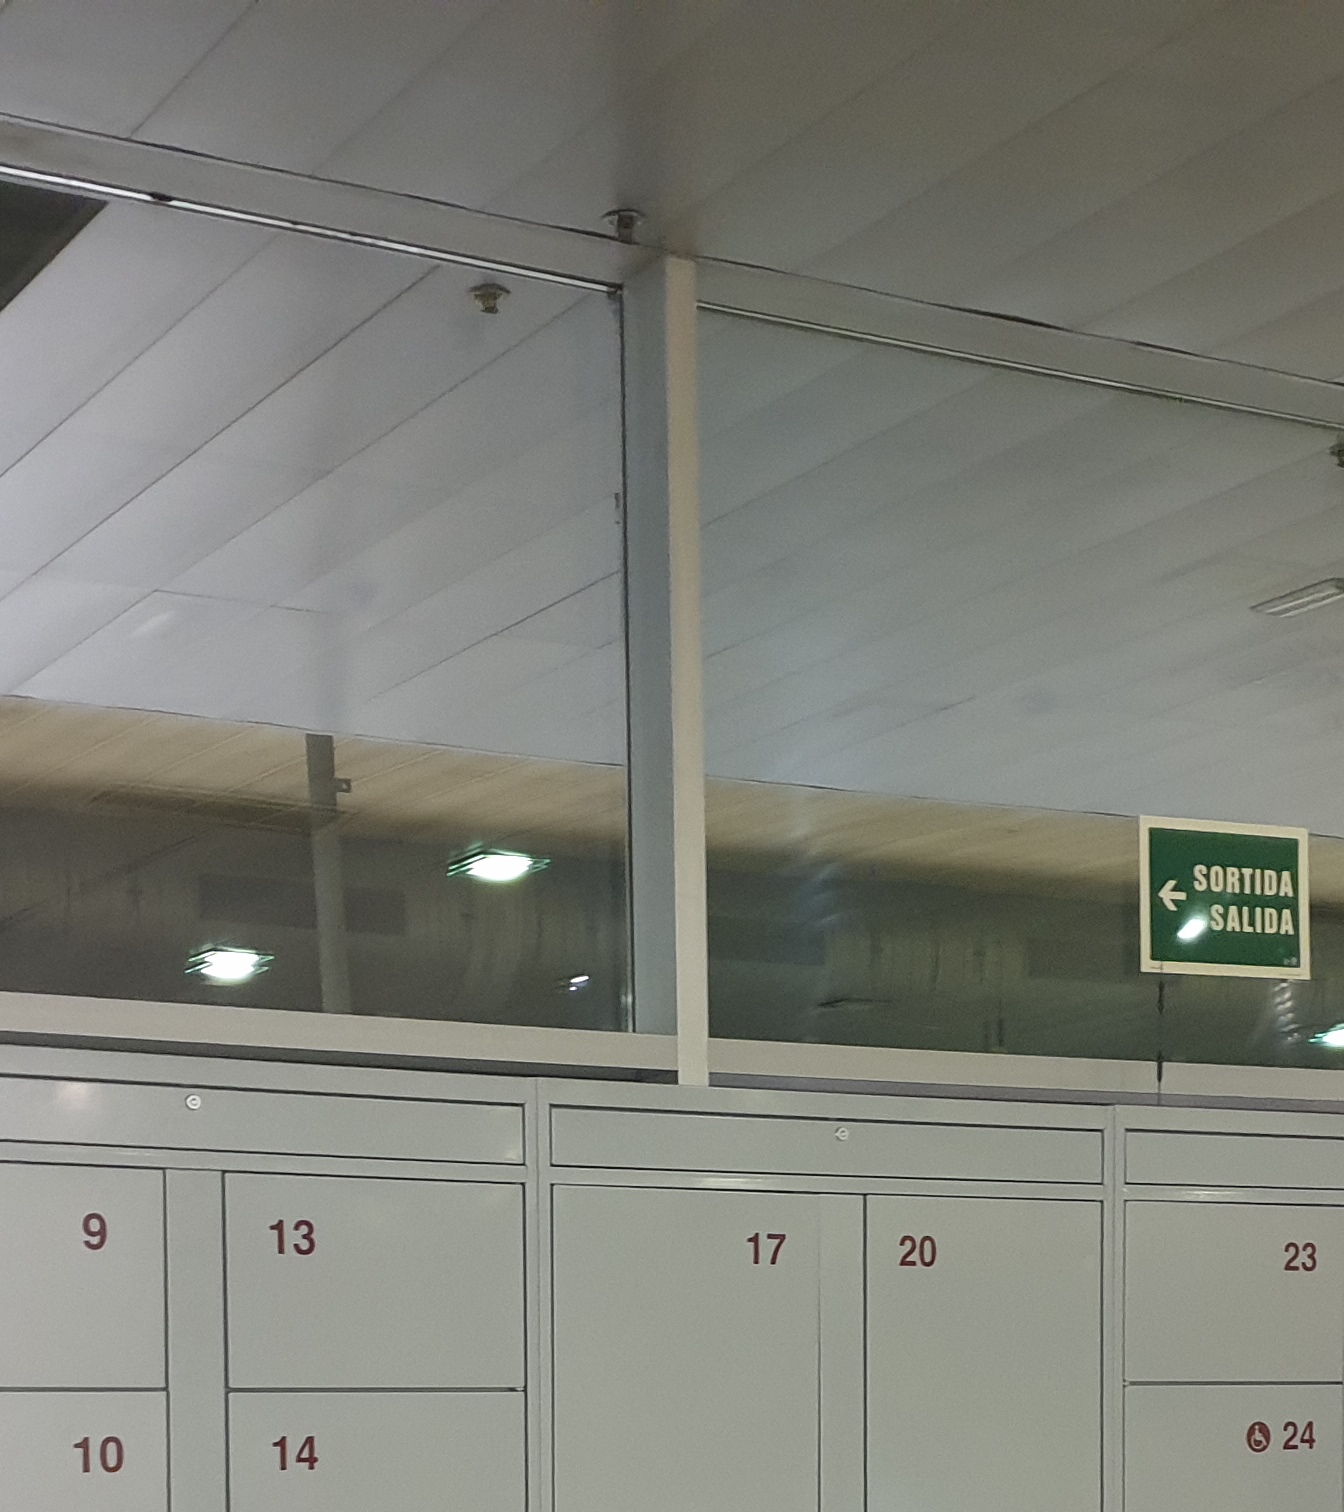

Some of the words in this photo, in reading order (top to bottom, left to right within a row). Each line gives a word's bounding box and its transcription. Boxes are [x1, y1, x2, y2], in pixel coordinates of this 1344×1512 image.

[1193, 864, 1294, 897] SORTIDA
[1210, 904, 1295, 935] SALIDA
[82, 1213, 108, 1251] 9
[269, 1220, 316, 1256] 13
[746, 1233, 787, 1266] 17
[898, 1236, 937, 1268] 20
[1283, 1242, 1317, 1272] 23
[1282, 1421, 1318, 1451] 24
[73, 1436, 124, 1474] 10
[272, 1436, 319, 1471] 14
